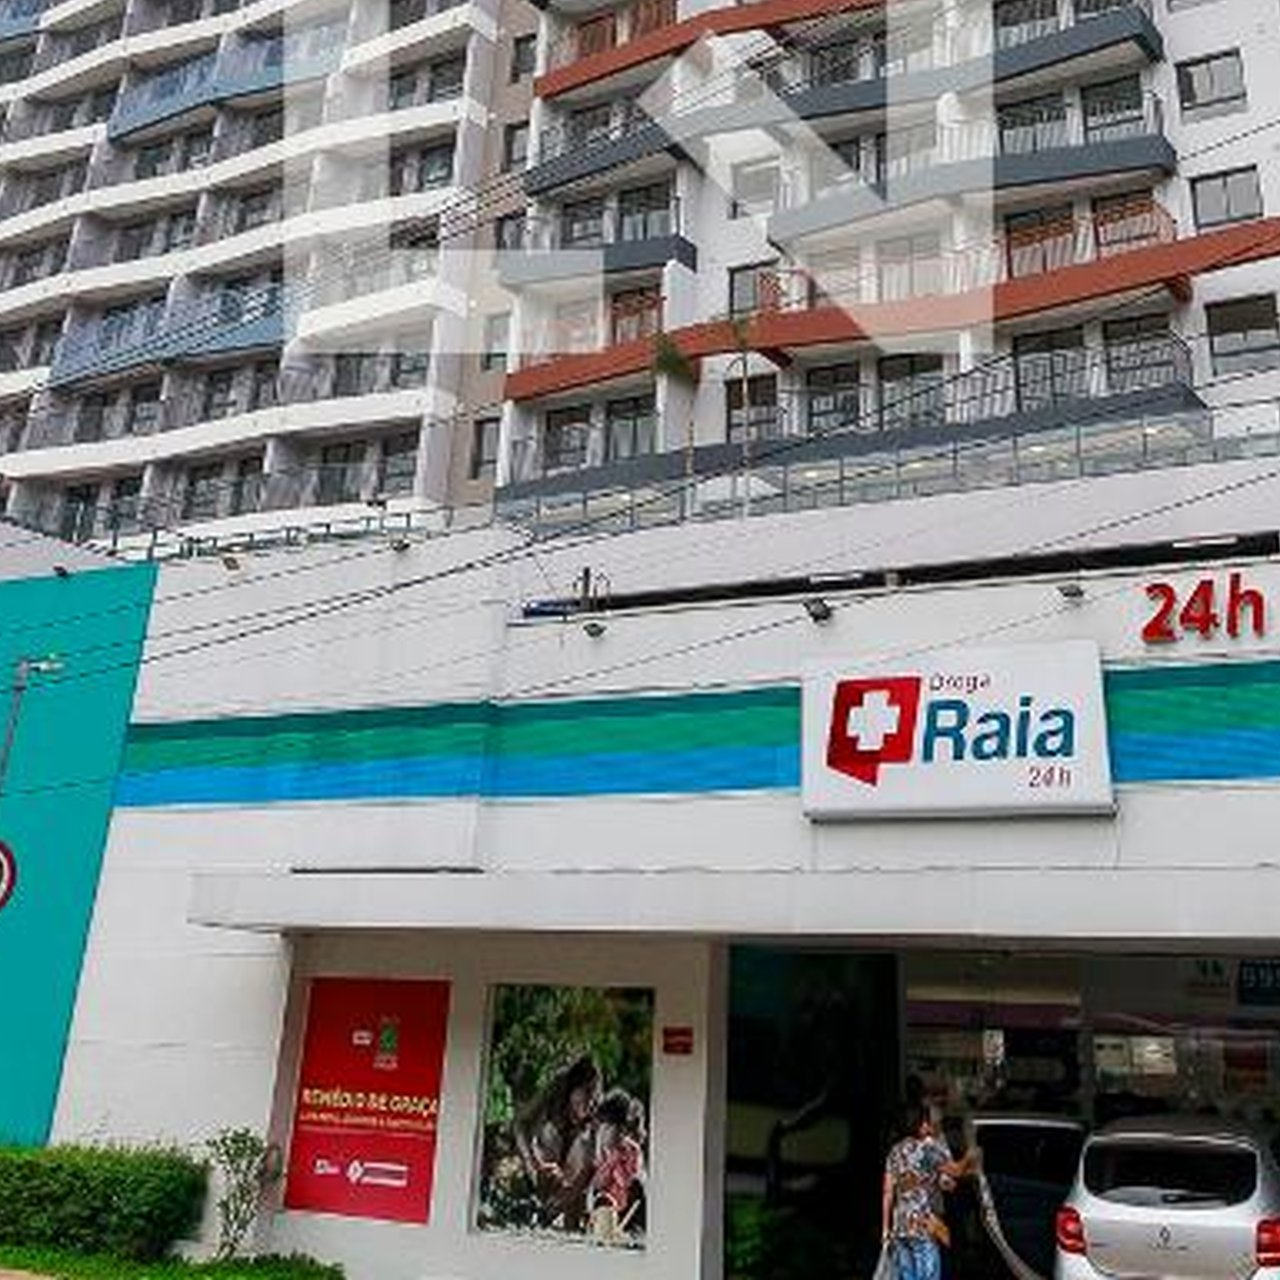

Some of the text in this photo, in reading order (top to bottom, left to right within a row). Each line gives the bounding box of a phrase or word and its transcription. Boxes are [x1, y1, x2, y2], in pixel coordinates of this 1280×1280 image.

[1141, 572, 1265, 644] 24h
[929, 673, 991, 694] Droga
[922, 696, 1075, 763] Raia
[1029, 765, 1072, 787] 24h
